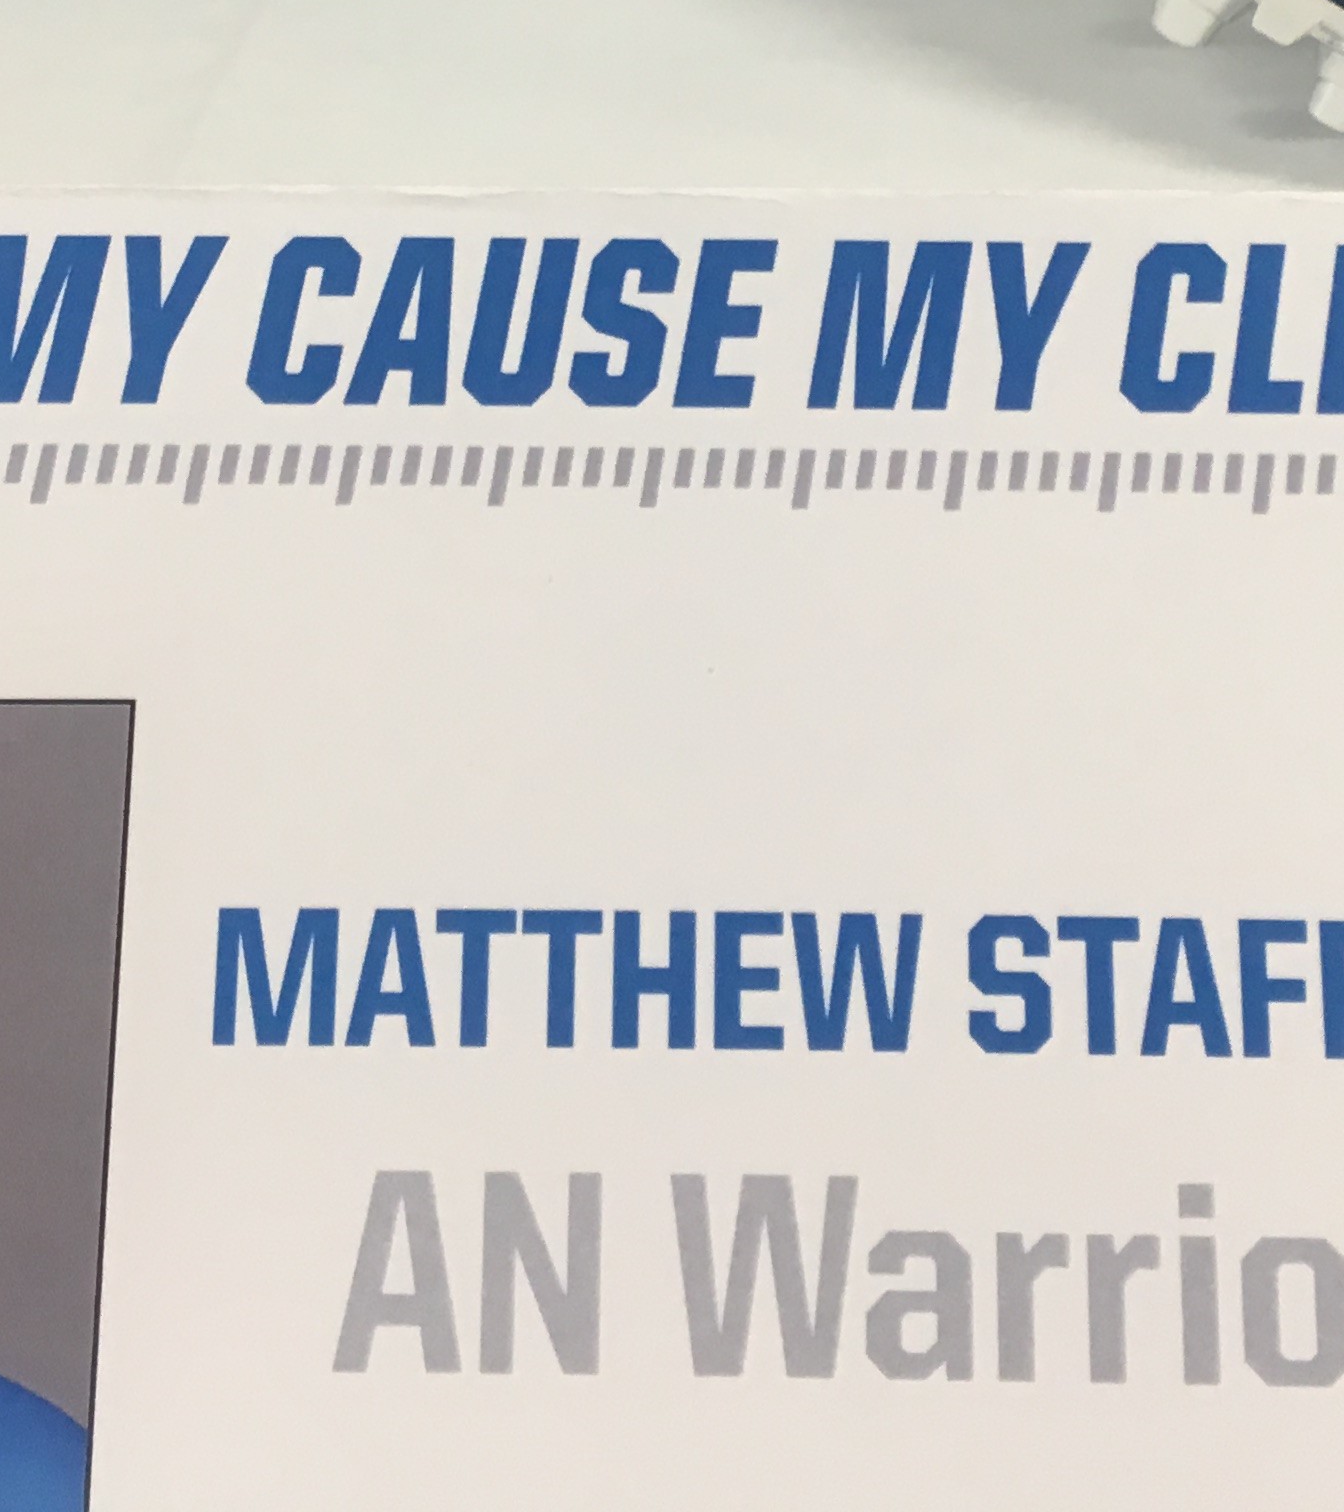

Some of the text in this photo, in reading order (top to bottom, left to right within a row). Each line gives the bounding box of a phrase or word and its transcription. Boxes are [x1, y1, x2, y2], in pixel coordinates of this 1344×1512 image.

[247, 236, 778, 408] CAUSE
[808, 239, 1090, 411] MY
[213, 907, 922, 1052] MATTHEW
[332, 1169, 602, 1375] AN
